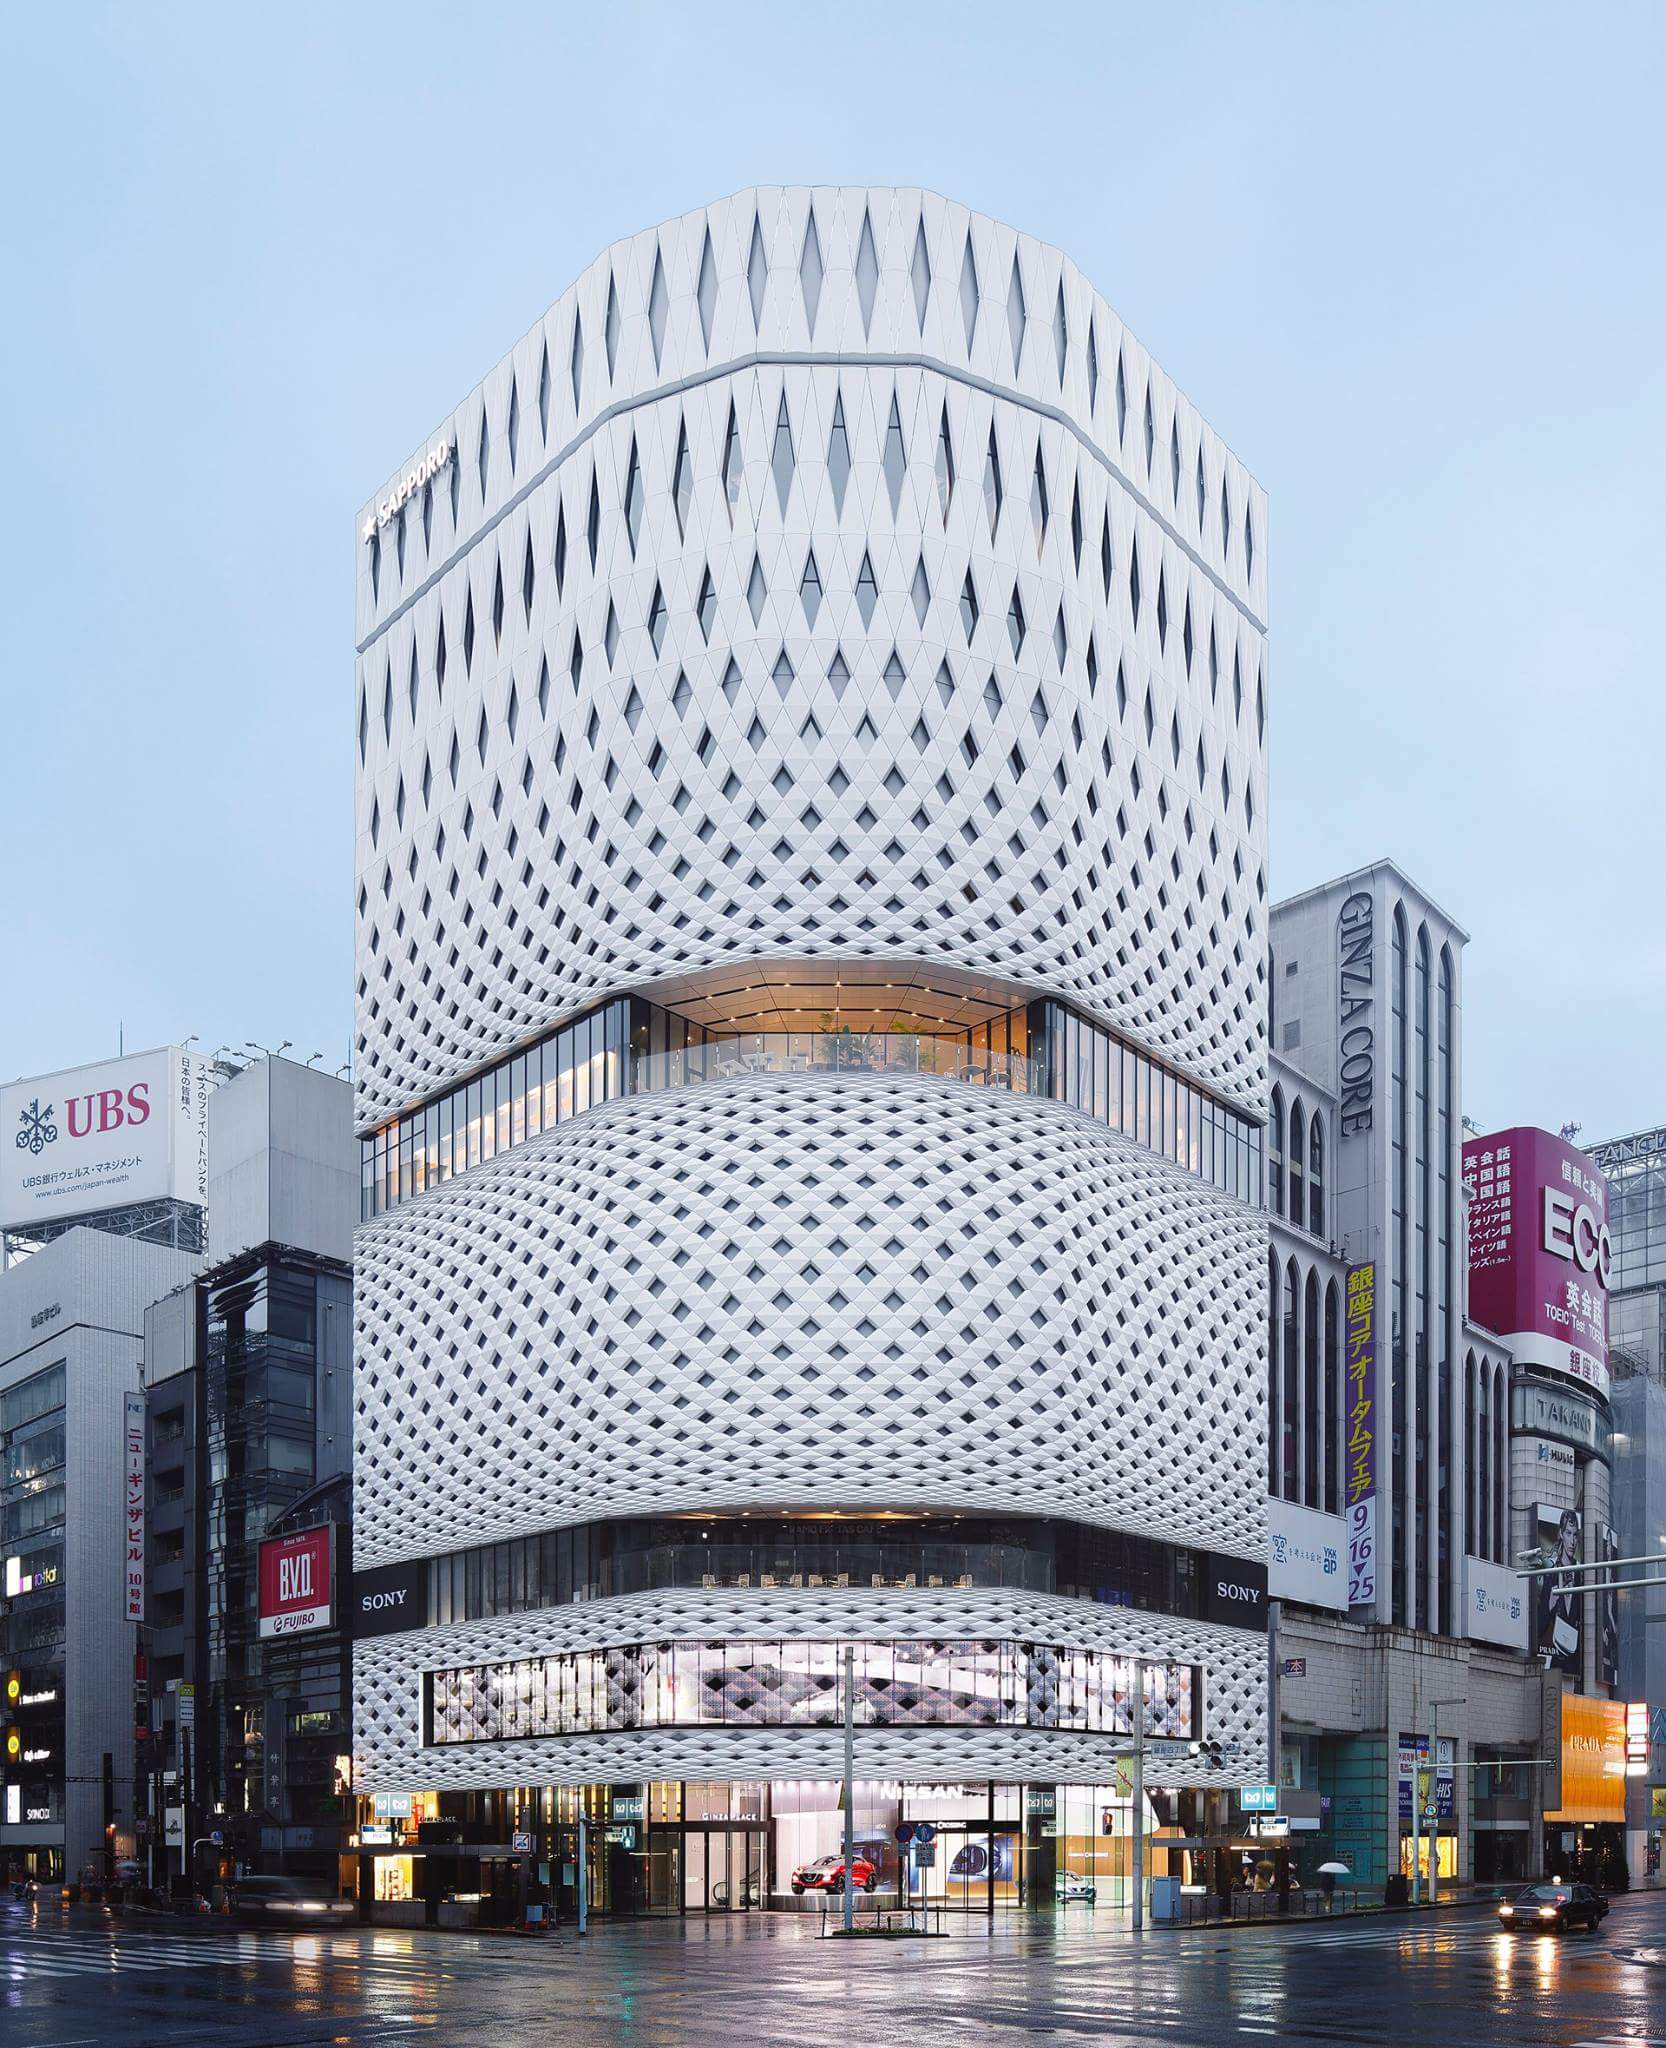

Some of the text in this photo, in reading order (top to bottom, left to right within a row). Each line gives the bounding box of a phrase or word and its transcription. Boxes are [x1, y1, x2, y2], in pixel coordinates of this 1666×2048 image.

[377, 439, 448, 527] SAPPORO
[1341, 892, 1373, 1137] GINZA CORE
[64, 1082, 150, 1138] UBS
[1464, 1146, 1511, 1170] 英会話
[22, 1155, 143, 1189] UBS銀行ウェルス・マネジメント
[1464, 1163, 1511, 1186] 中国語
[35, 1173, 130, 1198] www.ubs.com/japan-wealth
[1571, 1314, 1586, 1334] Test
[1347, 1265, 1374, 1503] 銀座コアオータムフェア
[1537, 1399, 1592, 1434] TAKANO
[127, 1428, 143, 1562] ニューギンザビル
[1323, 1547, 1337, 1560] YKK
[1323, 1558, 1337, 1575] ap
[362, 1589, 407, 1611] SONY
[1217, 1581, 1260, 1604] SONY
[1348, 1576, 1374, 1602] 25
[283, 1612, 315, 1630] FUJIBO
[1290, 1659, 1303, 1675] 本
[1570, 1733, 1602, 1752] PRADA
[880, 1785, 964, 1800] NISSAN
[1436, 1783, 1452, 1798] HIS
[702, 1812, 729, 1821] GINZA
